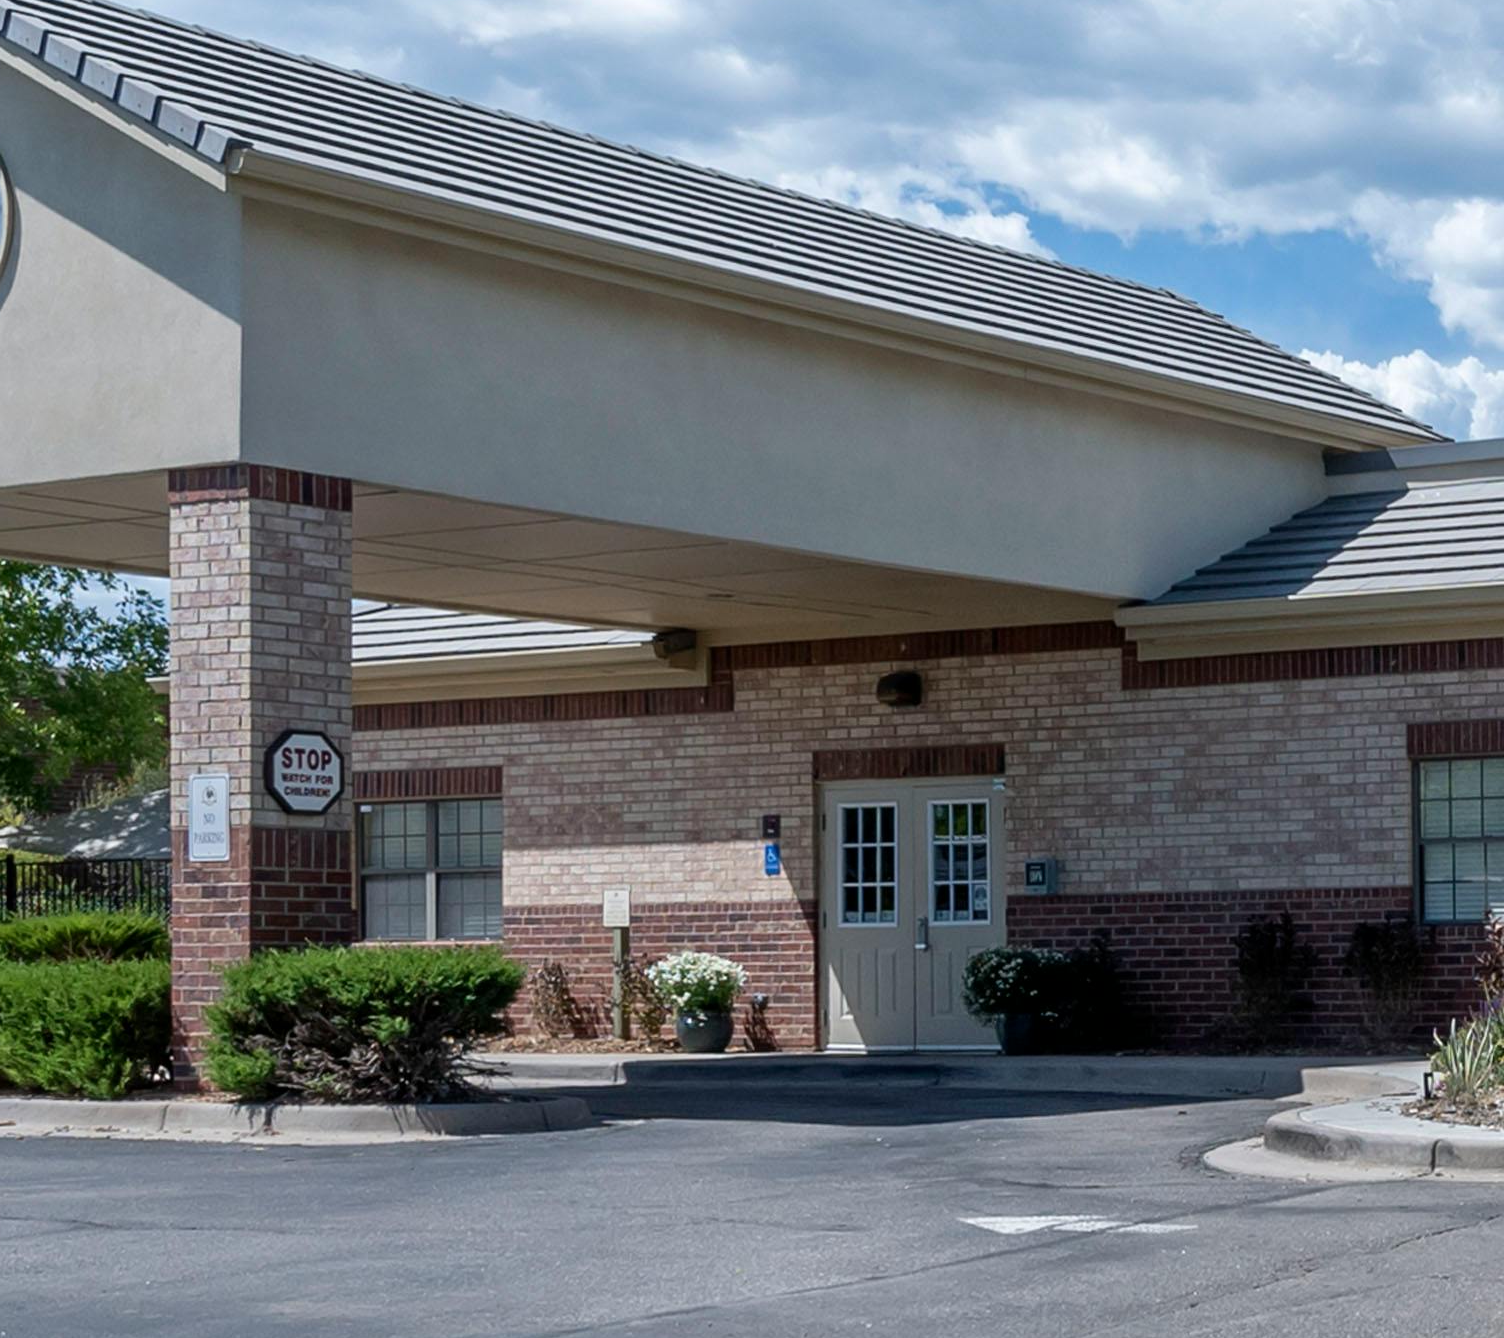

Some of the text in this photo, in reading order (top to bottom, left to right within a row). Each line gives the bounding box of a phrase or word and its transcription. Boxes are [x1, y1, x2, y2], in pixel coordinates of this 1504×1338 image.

[281, 746, 333, 771] STOP
[281, 772, 334, 785] WATCH FOR
